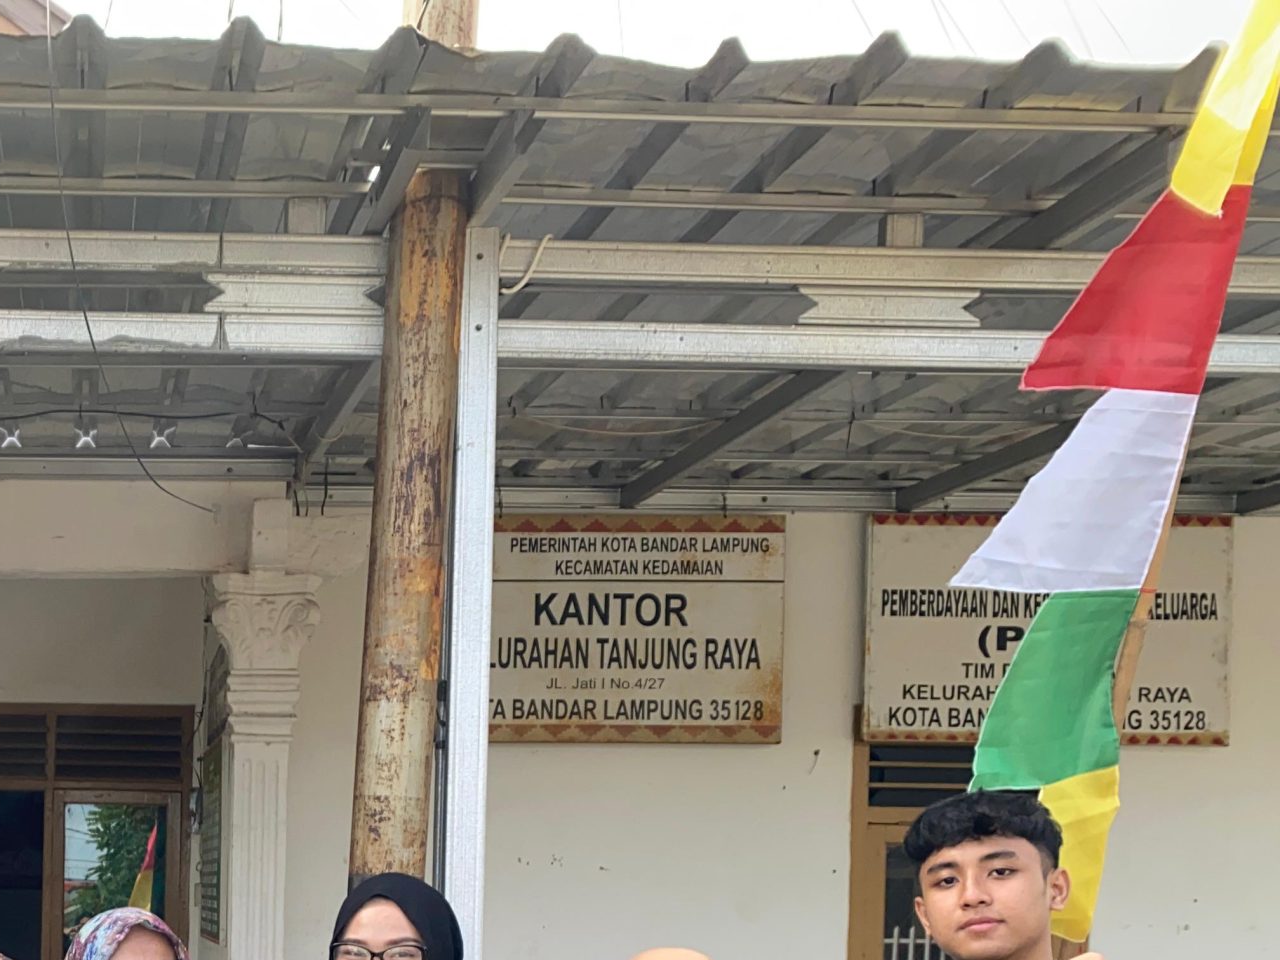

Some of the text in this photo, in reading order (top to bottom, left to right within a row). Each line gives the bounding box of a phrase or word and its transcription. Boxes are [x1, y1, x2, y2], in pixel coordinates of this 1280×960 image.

[510, 537, 770, 553] PEMERINTAH KOTA BANDAR LAMPUNG
[555, 560, 723, 576] KECAMATAN KEDAMAIAN
[534, 592, 689, 627] KANTOR
[881, 589, 988, 618] PEMBERDAYAAN
[992, 591, 1019, 618] DAN
[489, 637, 761, 669] URAHAN TANJUNG RAYA
[961, 662, 995, 679] TIM
[546, 678, 568, 689] JL.
[572, 678, 597, 689] Jati
[610, 678, 665, 689] No.4/27
[1138, 687, 1192, 703] RAYA
[512, 699, 597, 720] BANDAR
[603, 699, 703, 720] LAMPUNG
[710, 700, 764, 721] 35128
[889, 707, 942, 727] KOTA
[1150, 710, 1206, 730] 35128
